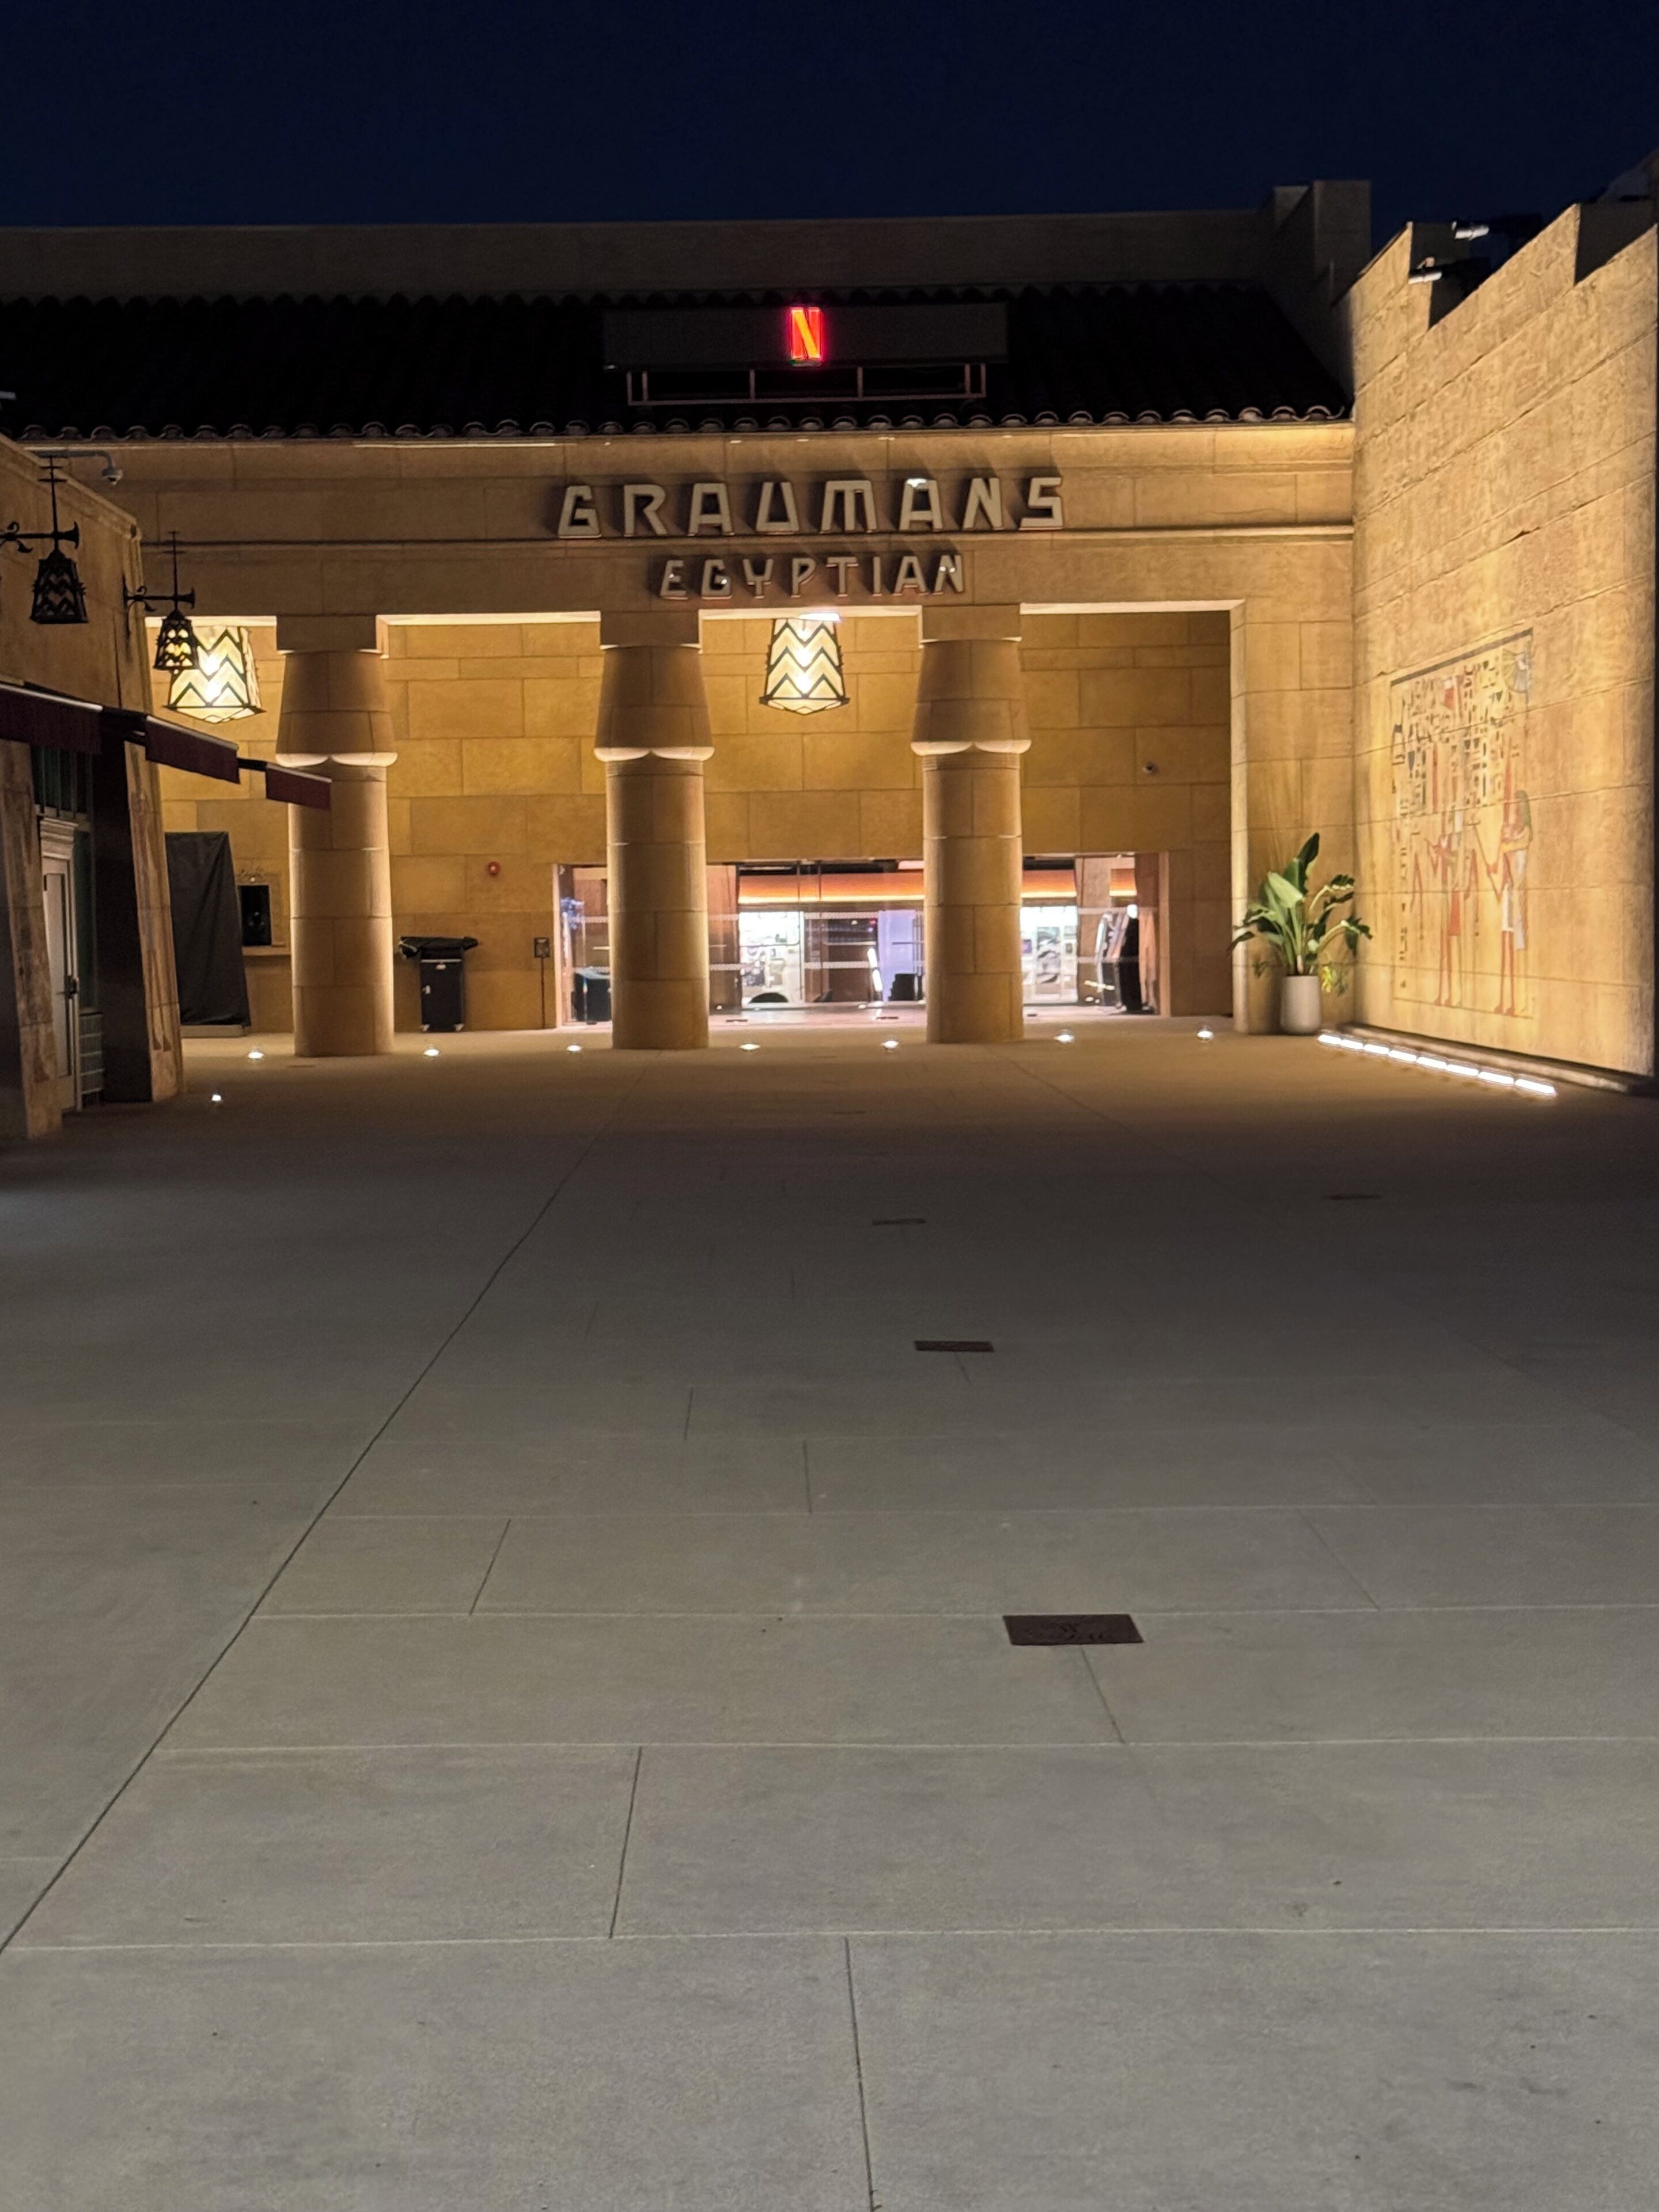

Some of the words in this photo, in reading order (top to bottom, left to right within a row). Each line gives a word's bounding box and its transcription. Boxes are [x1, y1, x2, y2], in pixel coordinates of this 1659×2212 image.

[790, 306, 821, 360] N
[558, 477, 1064, 539] GRAUMANS
[660, 555, 965, 600] EGYPTIAN
